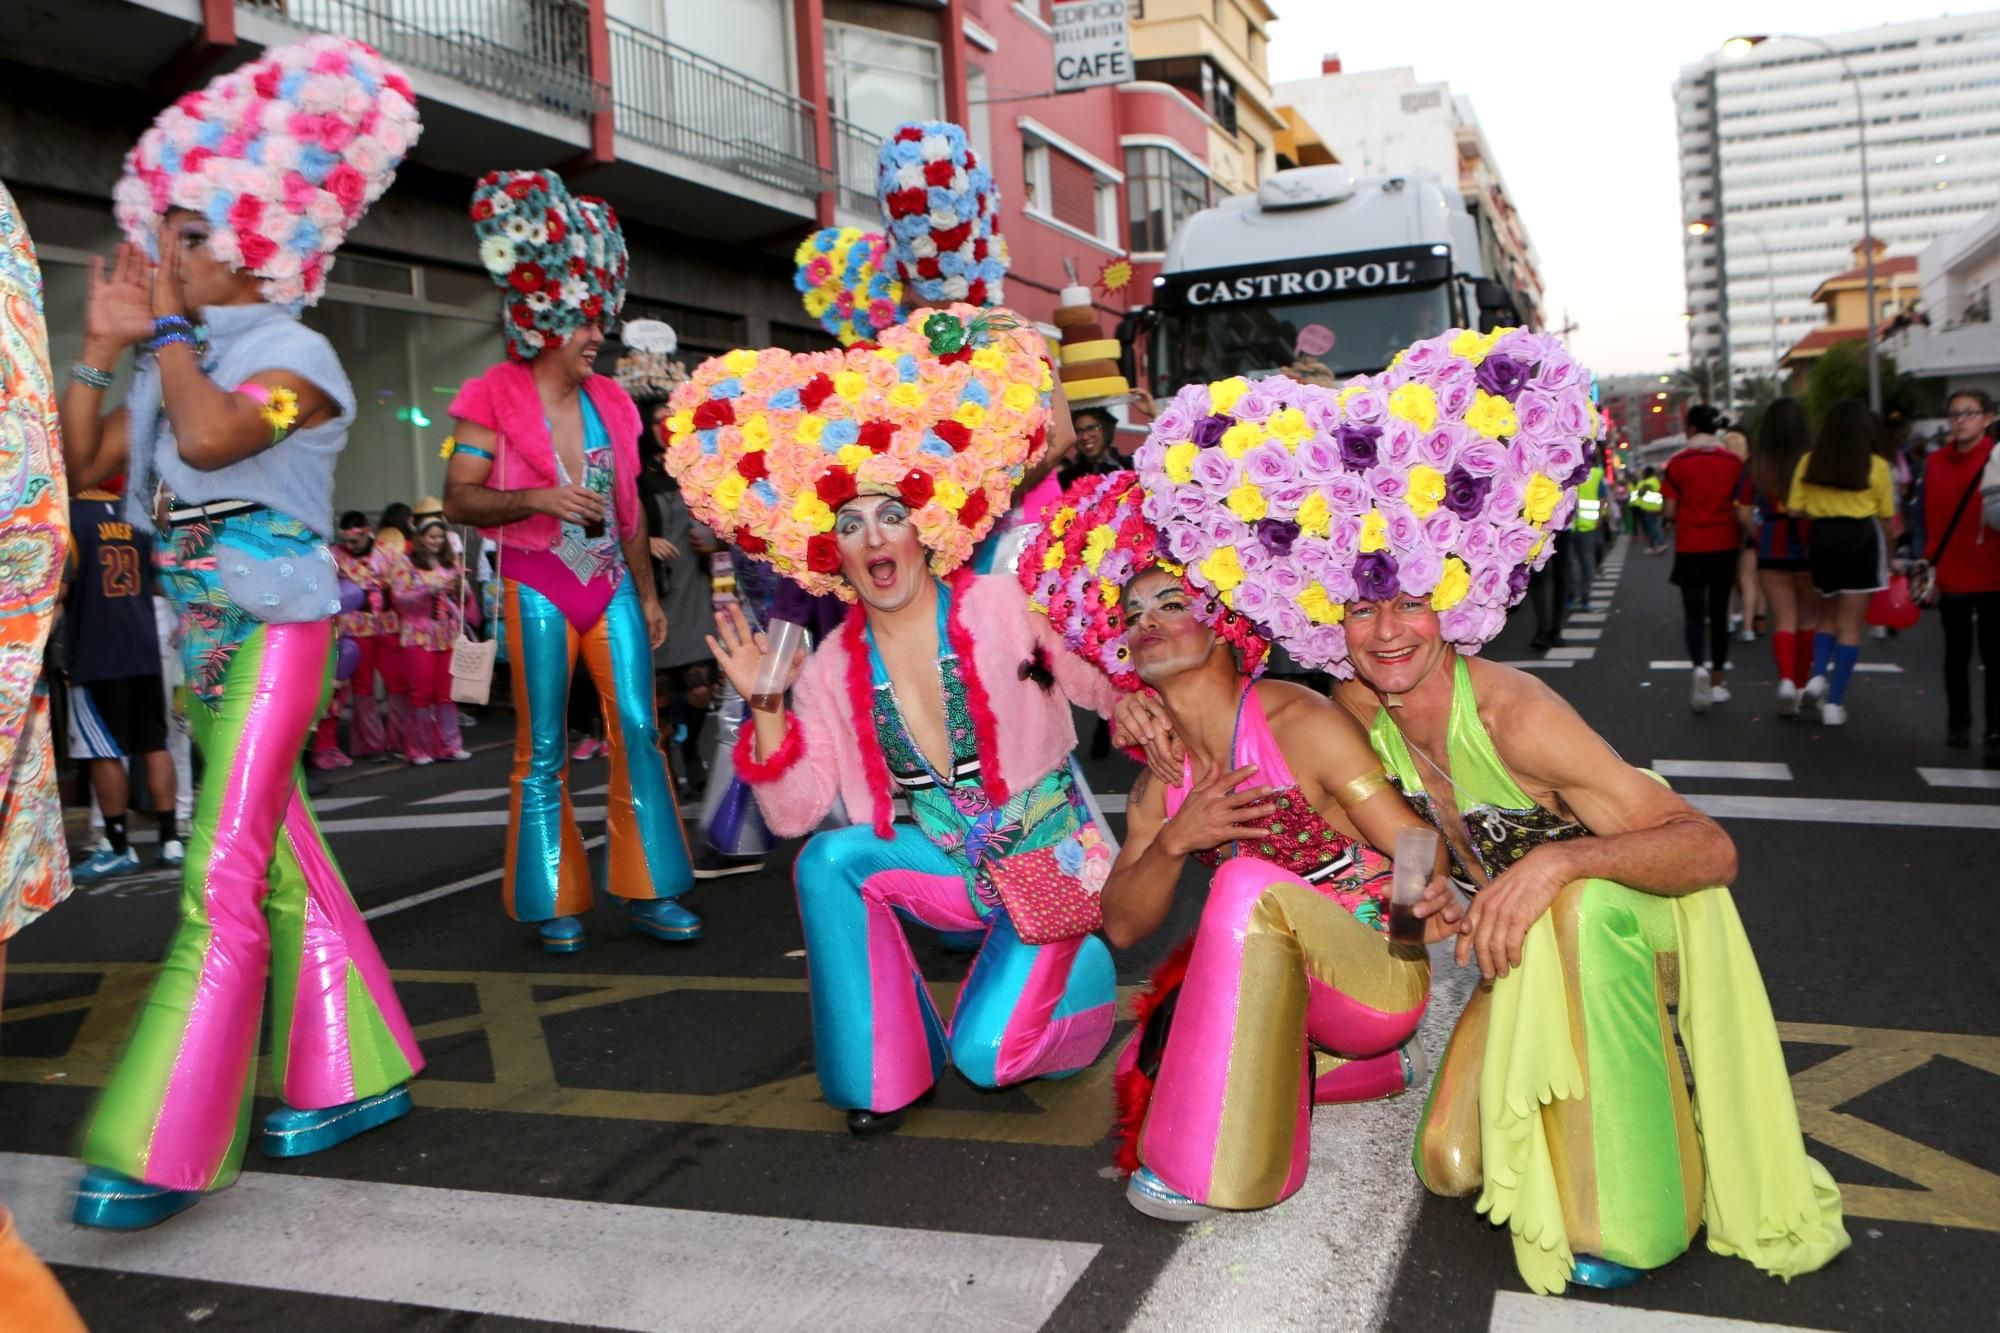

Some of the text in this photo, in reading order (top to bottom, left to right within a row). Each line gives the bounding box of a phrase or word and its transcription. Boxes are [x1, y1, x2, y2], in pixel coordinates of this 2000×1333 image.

[1053, 1, 1124, 26] EDIFICIO
[1057, 41, 1126, 81] CAFÉ
[98, 545, 140, 597] 23
